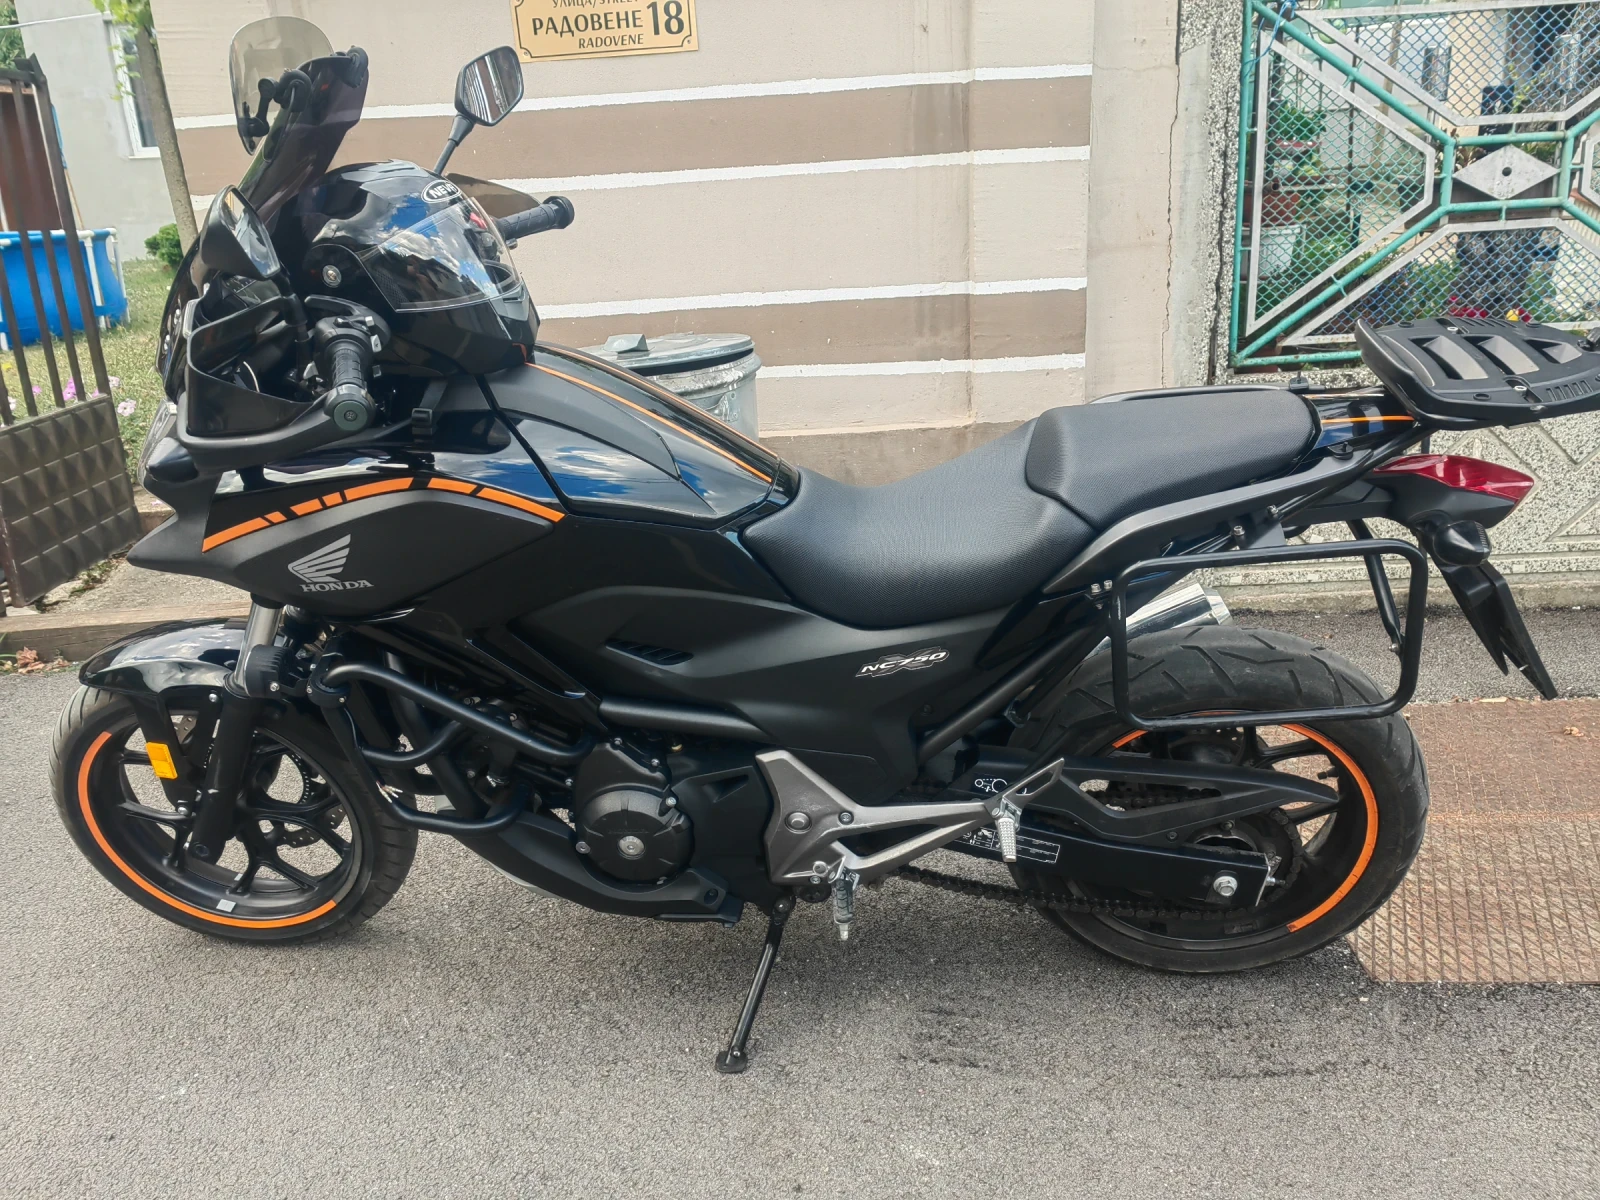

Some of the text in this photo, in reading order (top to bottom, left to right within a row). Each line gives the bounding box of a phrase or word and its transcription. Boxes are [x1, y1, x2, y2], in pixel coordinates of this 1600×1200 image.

[532, 10, 644, 38] РАДОВЕНЕ
[646, 1, 685, 36] 18
[579, 33, 644, 49] RADOVENE
[299, 579, 374, 593] HONDA
